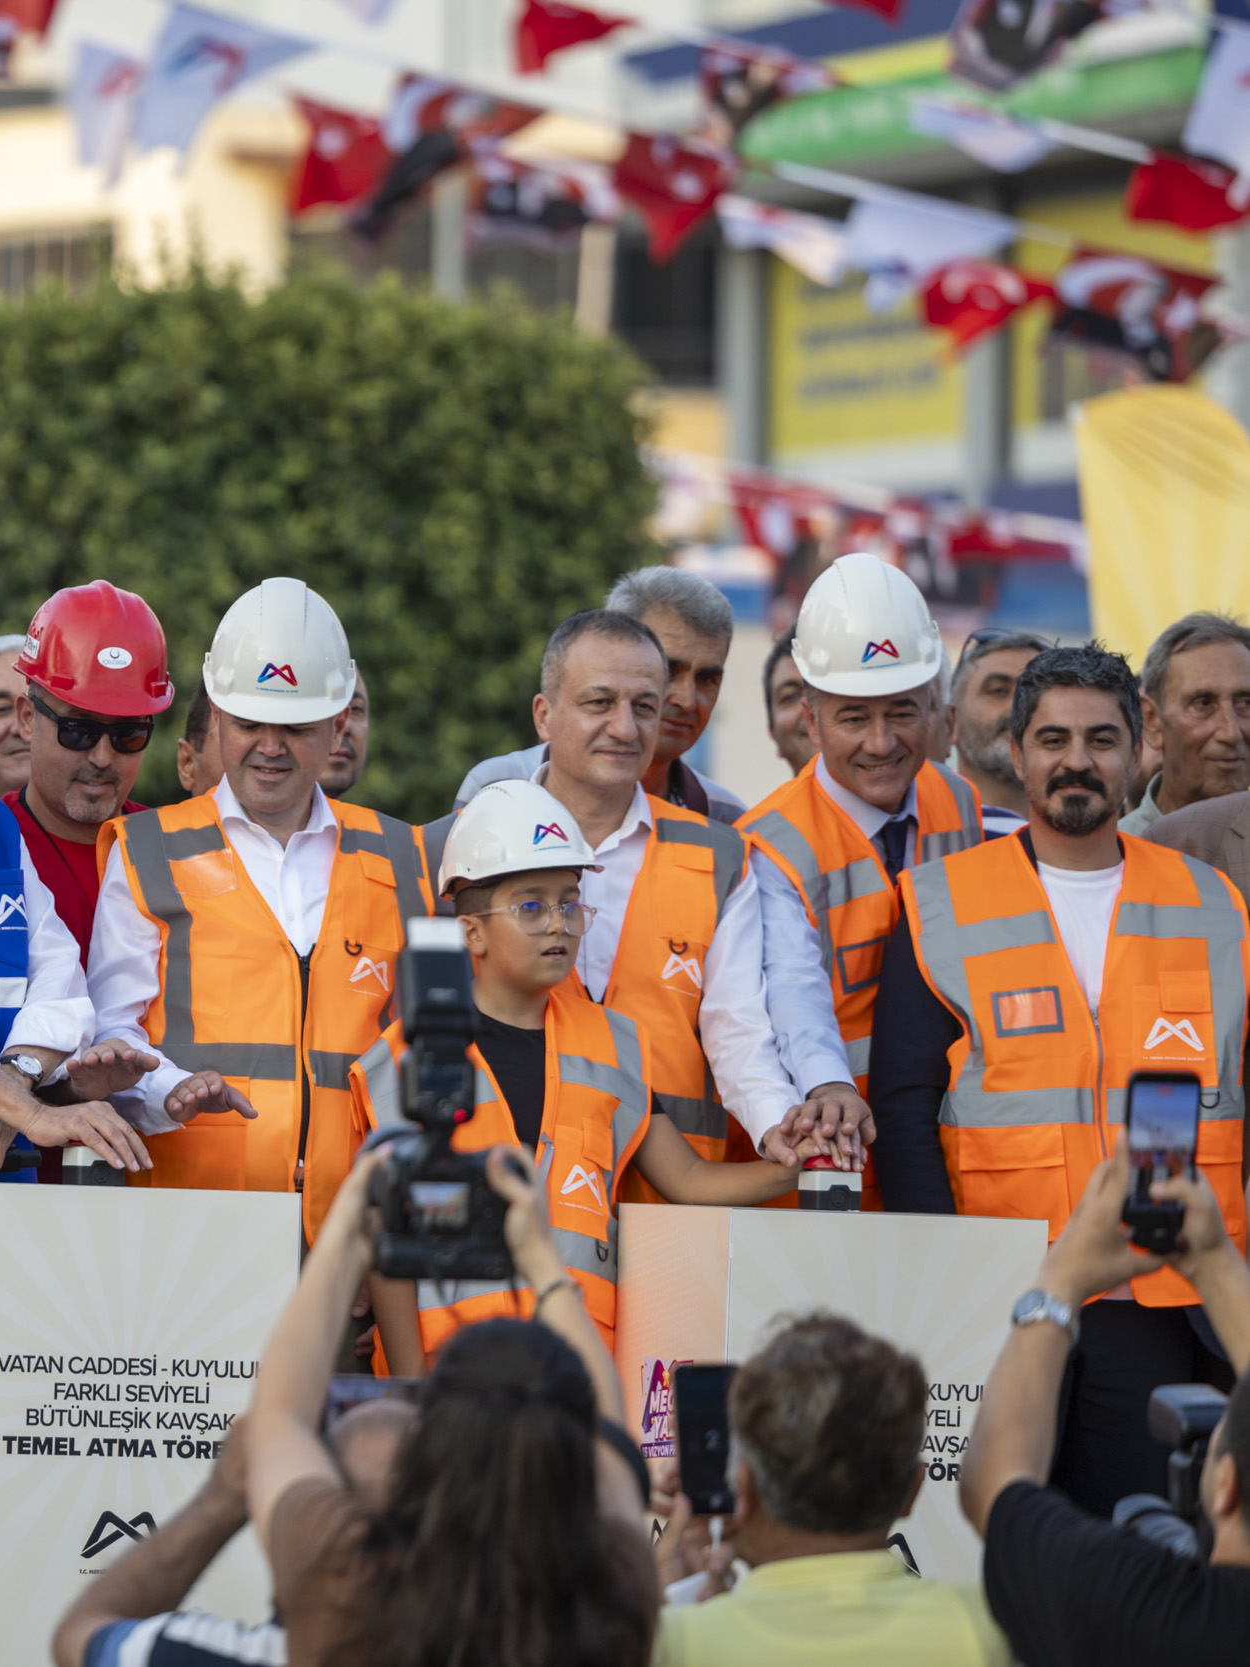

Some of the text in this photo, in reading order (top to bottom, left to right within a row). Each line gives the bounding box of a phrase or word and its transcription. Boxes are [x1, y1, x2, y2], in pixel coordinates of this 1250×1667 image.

[68, 1354, 157, 1376] CADDESİ
[54, 1381, 210, 1404] FARKLI SEVİYELİ
[649, 1389, 675, 1414] MEG
[926, 1383, 984, 1402] KUYU
[26, 1404, 236, 1435] BÜTÜNLEŞİK KAVŞAK
[924, 1406, 961, 1428] YELİ
[2, 1434, 226, 1459] TEMEL ATMA TÖRE
[920, 1435, 970, 1458] AVŞA
